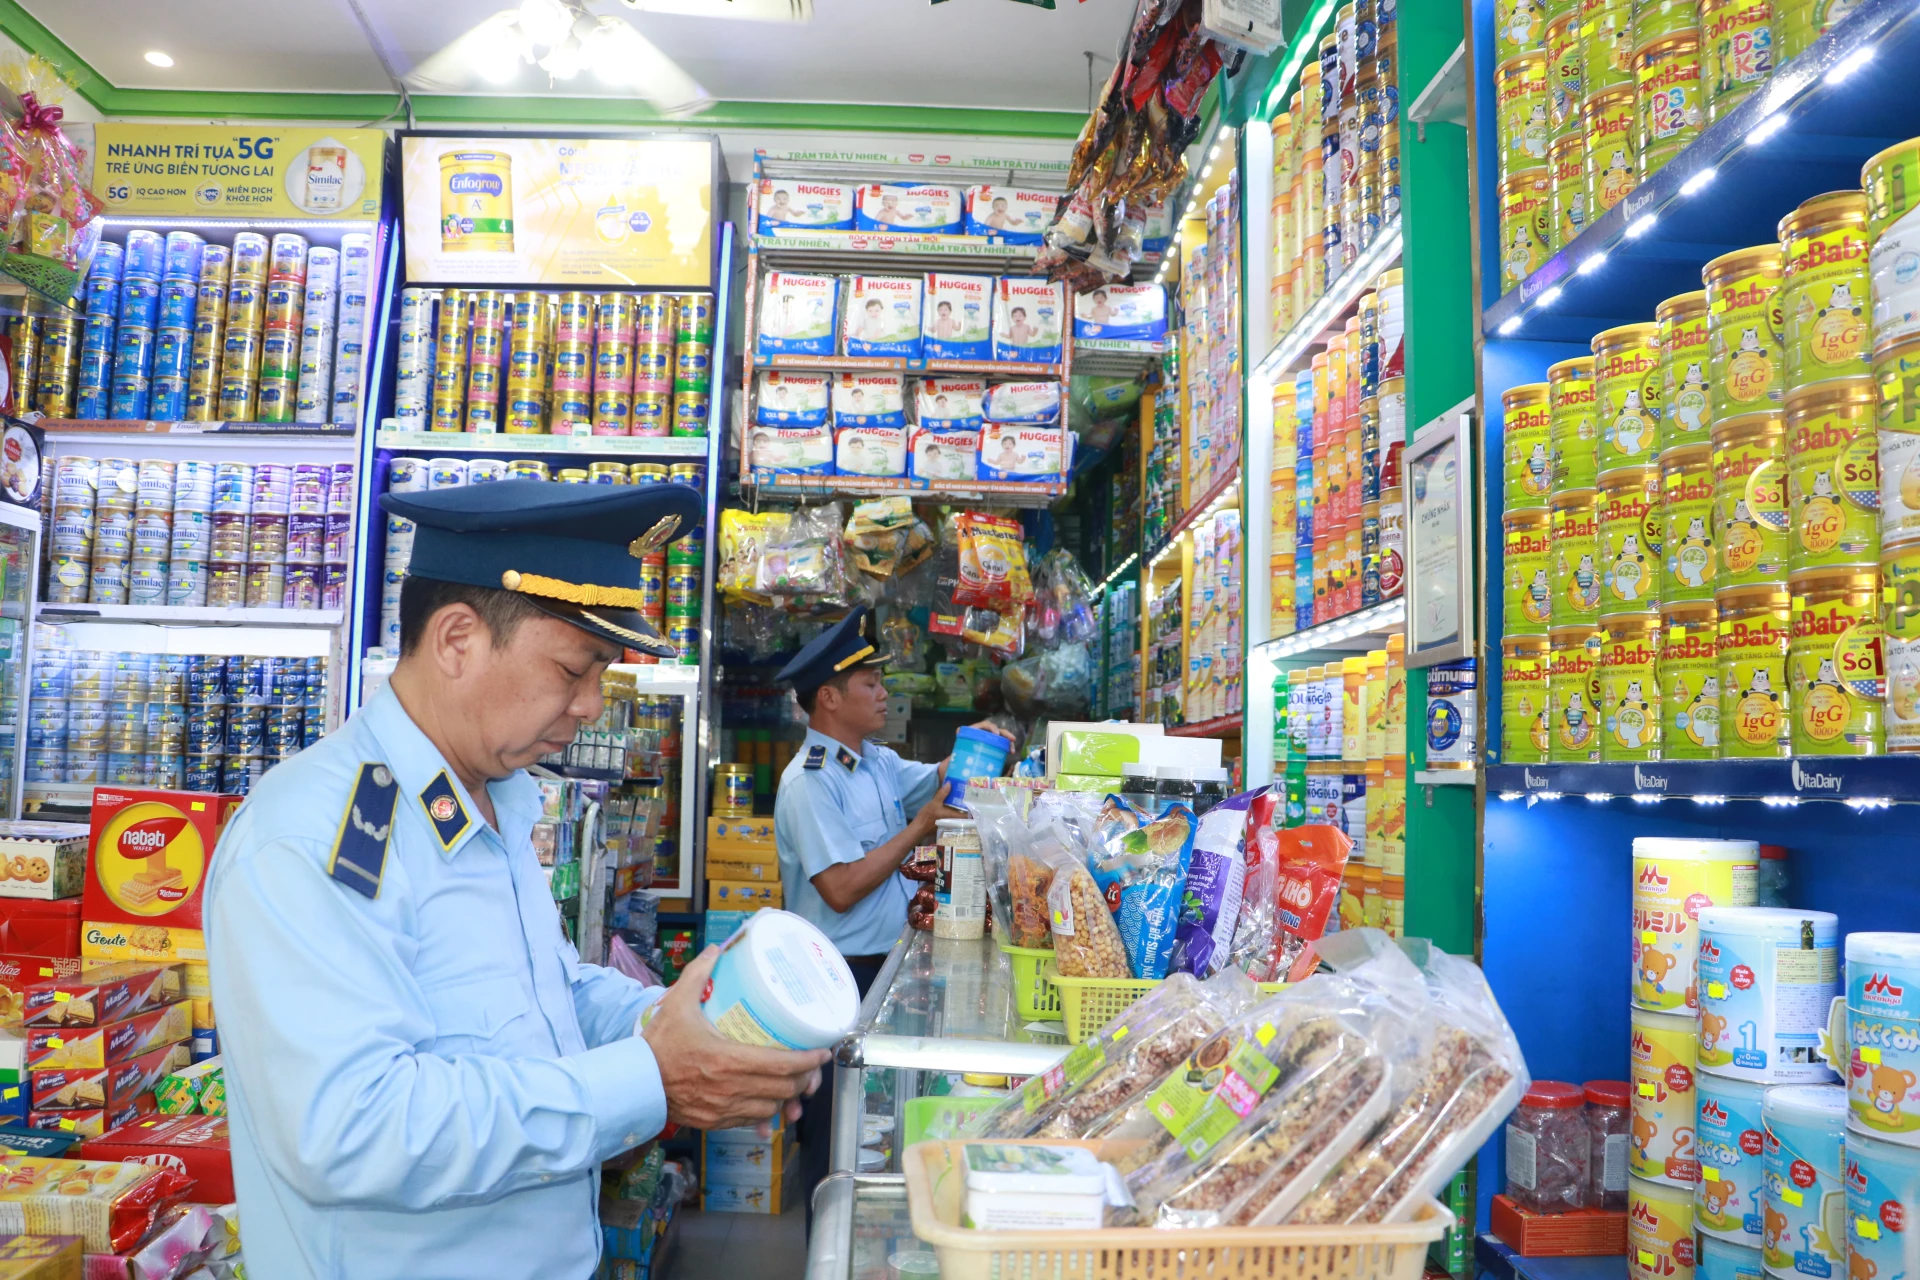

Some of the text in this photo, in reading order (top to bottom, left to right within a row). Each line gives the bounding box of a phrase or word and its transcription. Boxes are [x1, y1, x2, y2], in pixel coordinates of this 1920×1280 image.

[108, 143, 170, 158] NHANH
[175, 143, 200, 158] TRÍ
[203, 146, 235, 162] TỰA
[134, 161, 164, 175] ỨNG
[168, 161, 198, 175] BIẾN
[202, 164, 250, 176] TƯƠNG
[253, 166, 274, 177] LAI
[308, 175, 342, 186] Similac
[451, 176, 500, 192] Enfagrow
[108, 187, 128, 200] 5G
[136, 188, 187, 196] IQ CAO HƠN
[798, 185, 841, 196] HUGGIES
[1604, 183, 1632, 200] IgG
[254, 195, 273, 203] HƠN
[1016, 192, 1060, 204] HUGGIES
[499, 219, 507, 233] 4
[782, 278, 826, 288] HUGGIES
[867, 281, 912, 290] HUGGIES
[939, 280, 982, 292] HUGGIES
[1012, 286, 1054, 296] HUGGIES
[1821, 328, 1858, 350] IgG
[784, 376, 823, 385] HUGGIES
[858, 377, 898, 386] HUGGIES
[1733, 368, 1766, 392] IgG
[941, 383, 980, 392] HUGGIES
[1010, 384, 1048, 394] HUGGIES
[933, 435, 974, 446] HUGGIES
[1020, 432, 1062, 443] HUGGIES
[60, 477, 88, 486] Simila
[1804, 517, 1838, 536] IgG
[136, 528, 170, 538] Similac
[132, 578, 164, 588] Similac
[1842, 651, 1872, 672] Số
[191, 670, 220, 682] Ensure
[1810, 705, 1844, 726] IgG
[1743, 712, 1776, 732] IgG
[187, 772, 216, 782] Ensure
[1792, 760, 1842, 792] VitaDairy
[123, 829, 166, 848] nabati
[1286, 877, 1312, 906] KHÔ
[1144, 940, 1158, 965] SUNG
[104, 984, 130, 1010] Magic
[1864, 994, 1901, 1005] morinaga
[110, 1026, 134, 1050] Magic
[38, 1073, 64, 1086] Magic
[115, 1067, 140, 1090] Magic
